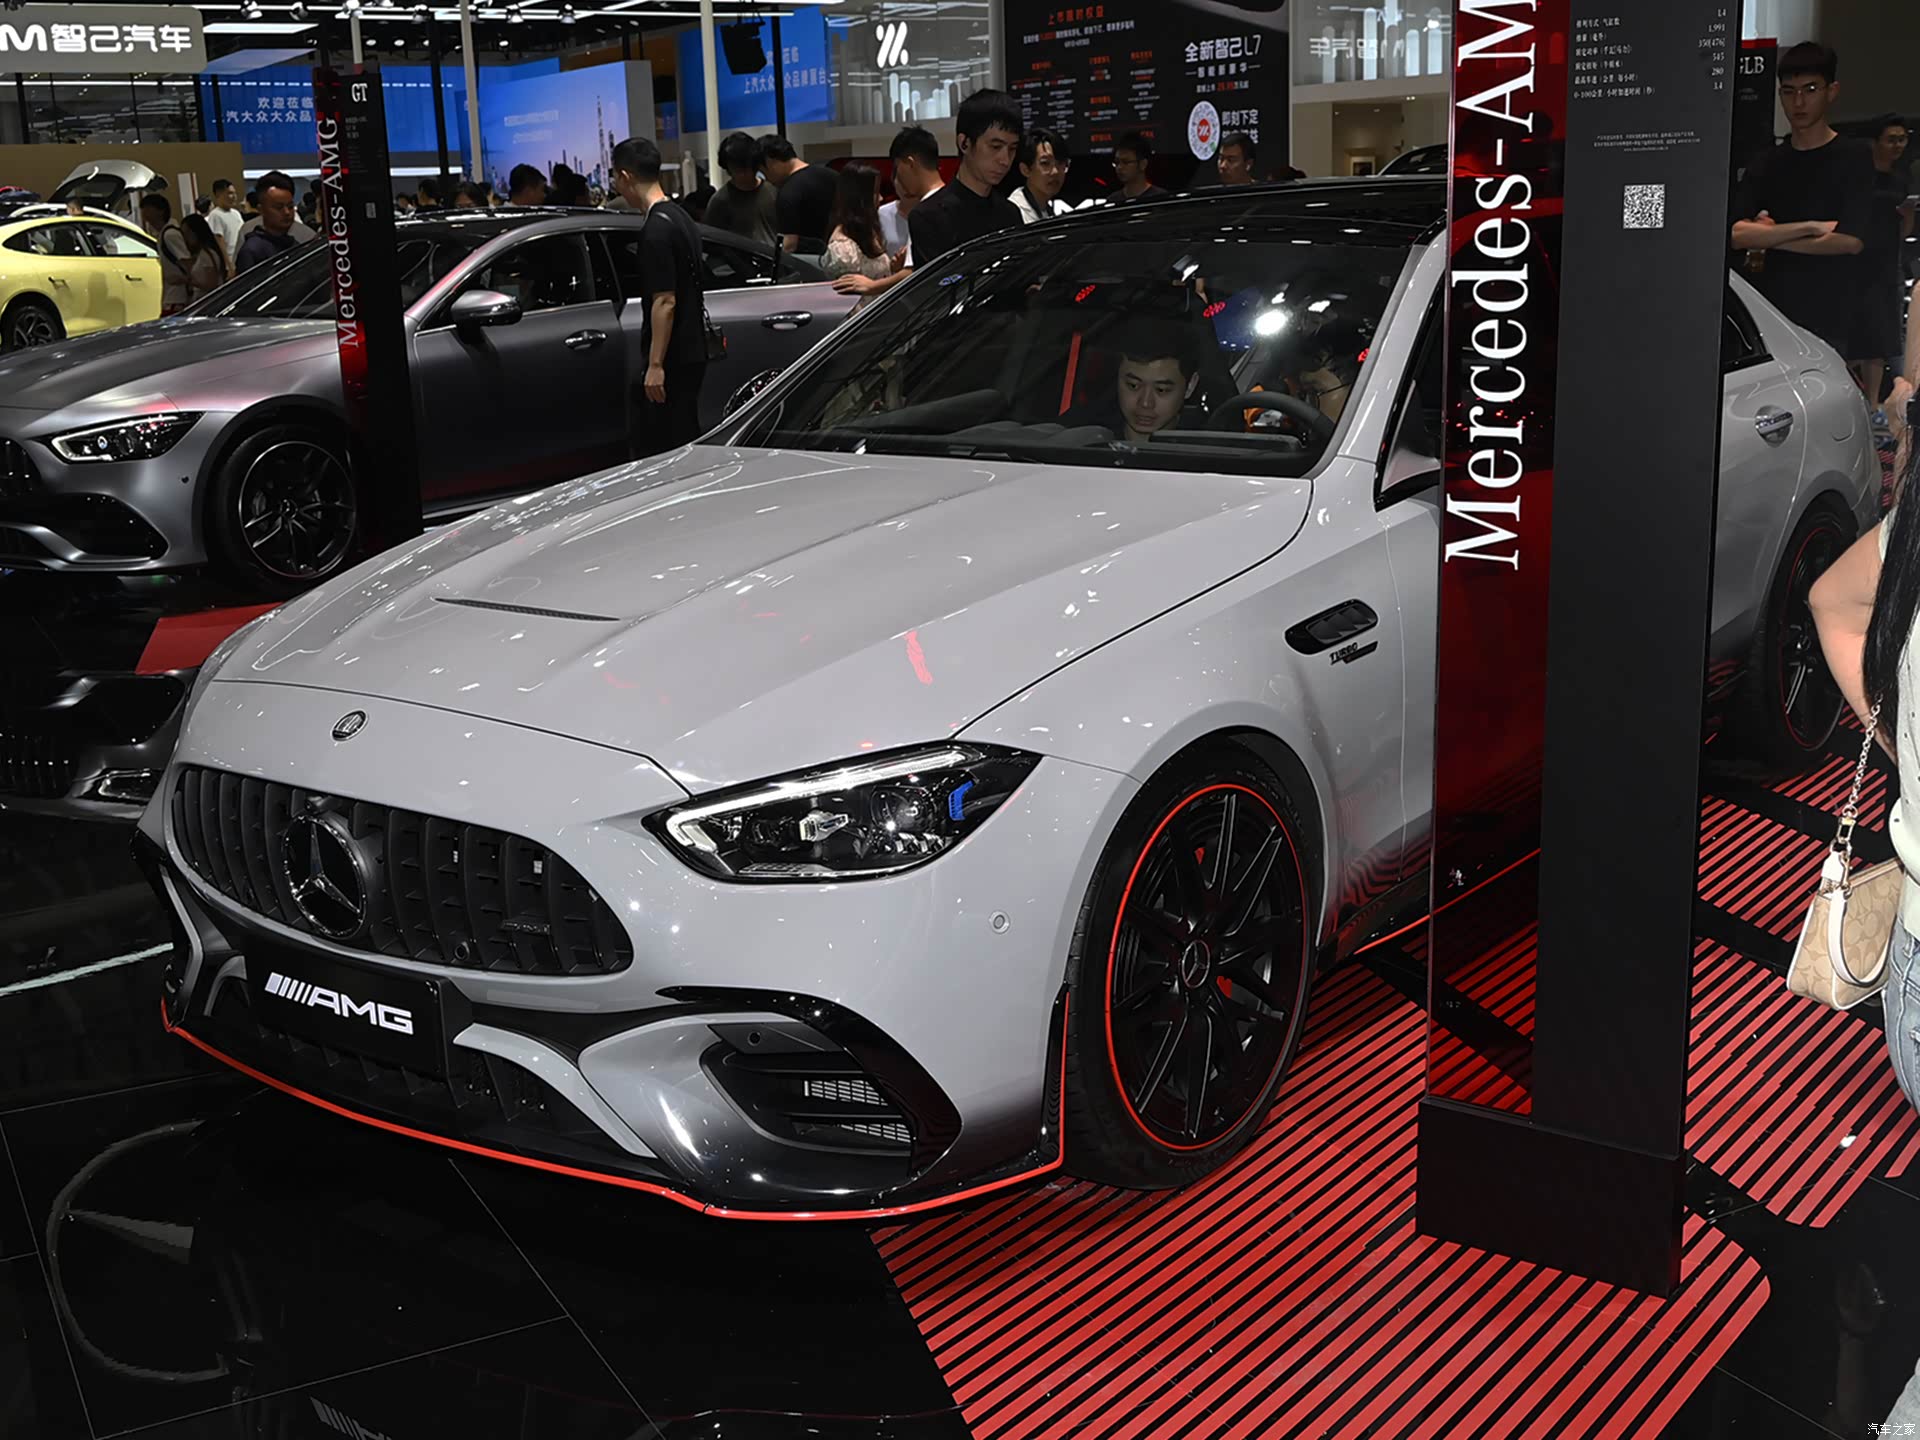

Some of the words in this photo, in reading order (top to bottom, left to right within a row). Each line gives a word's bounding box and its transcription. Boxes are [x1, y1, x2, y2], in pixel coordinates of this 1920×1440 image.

[1184, 34, 1262, 63] 全新智己L7
[257, 96, 314, 110] 欢迎莅临
[351, 82, 368, 103] GT
[316, 116, 360, 348] Mercedes-AMG
[306, 984, 415, 1036] AMG
